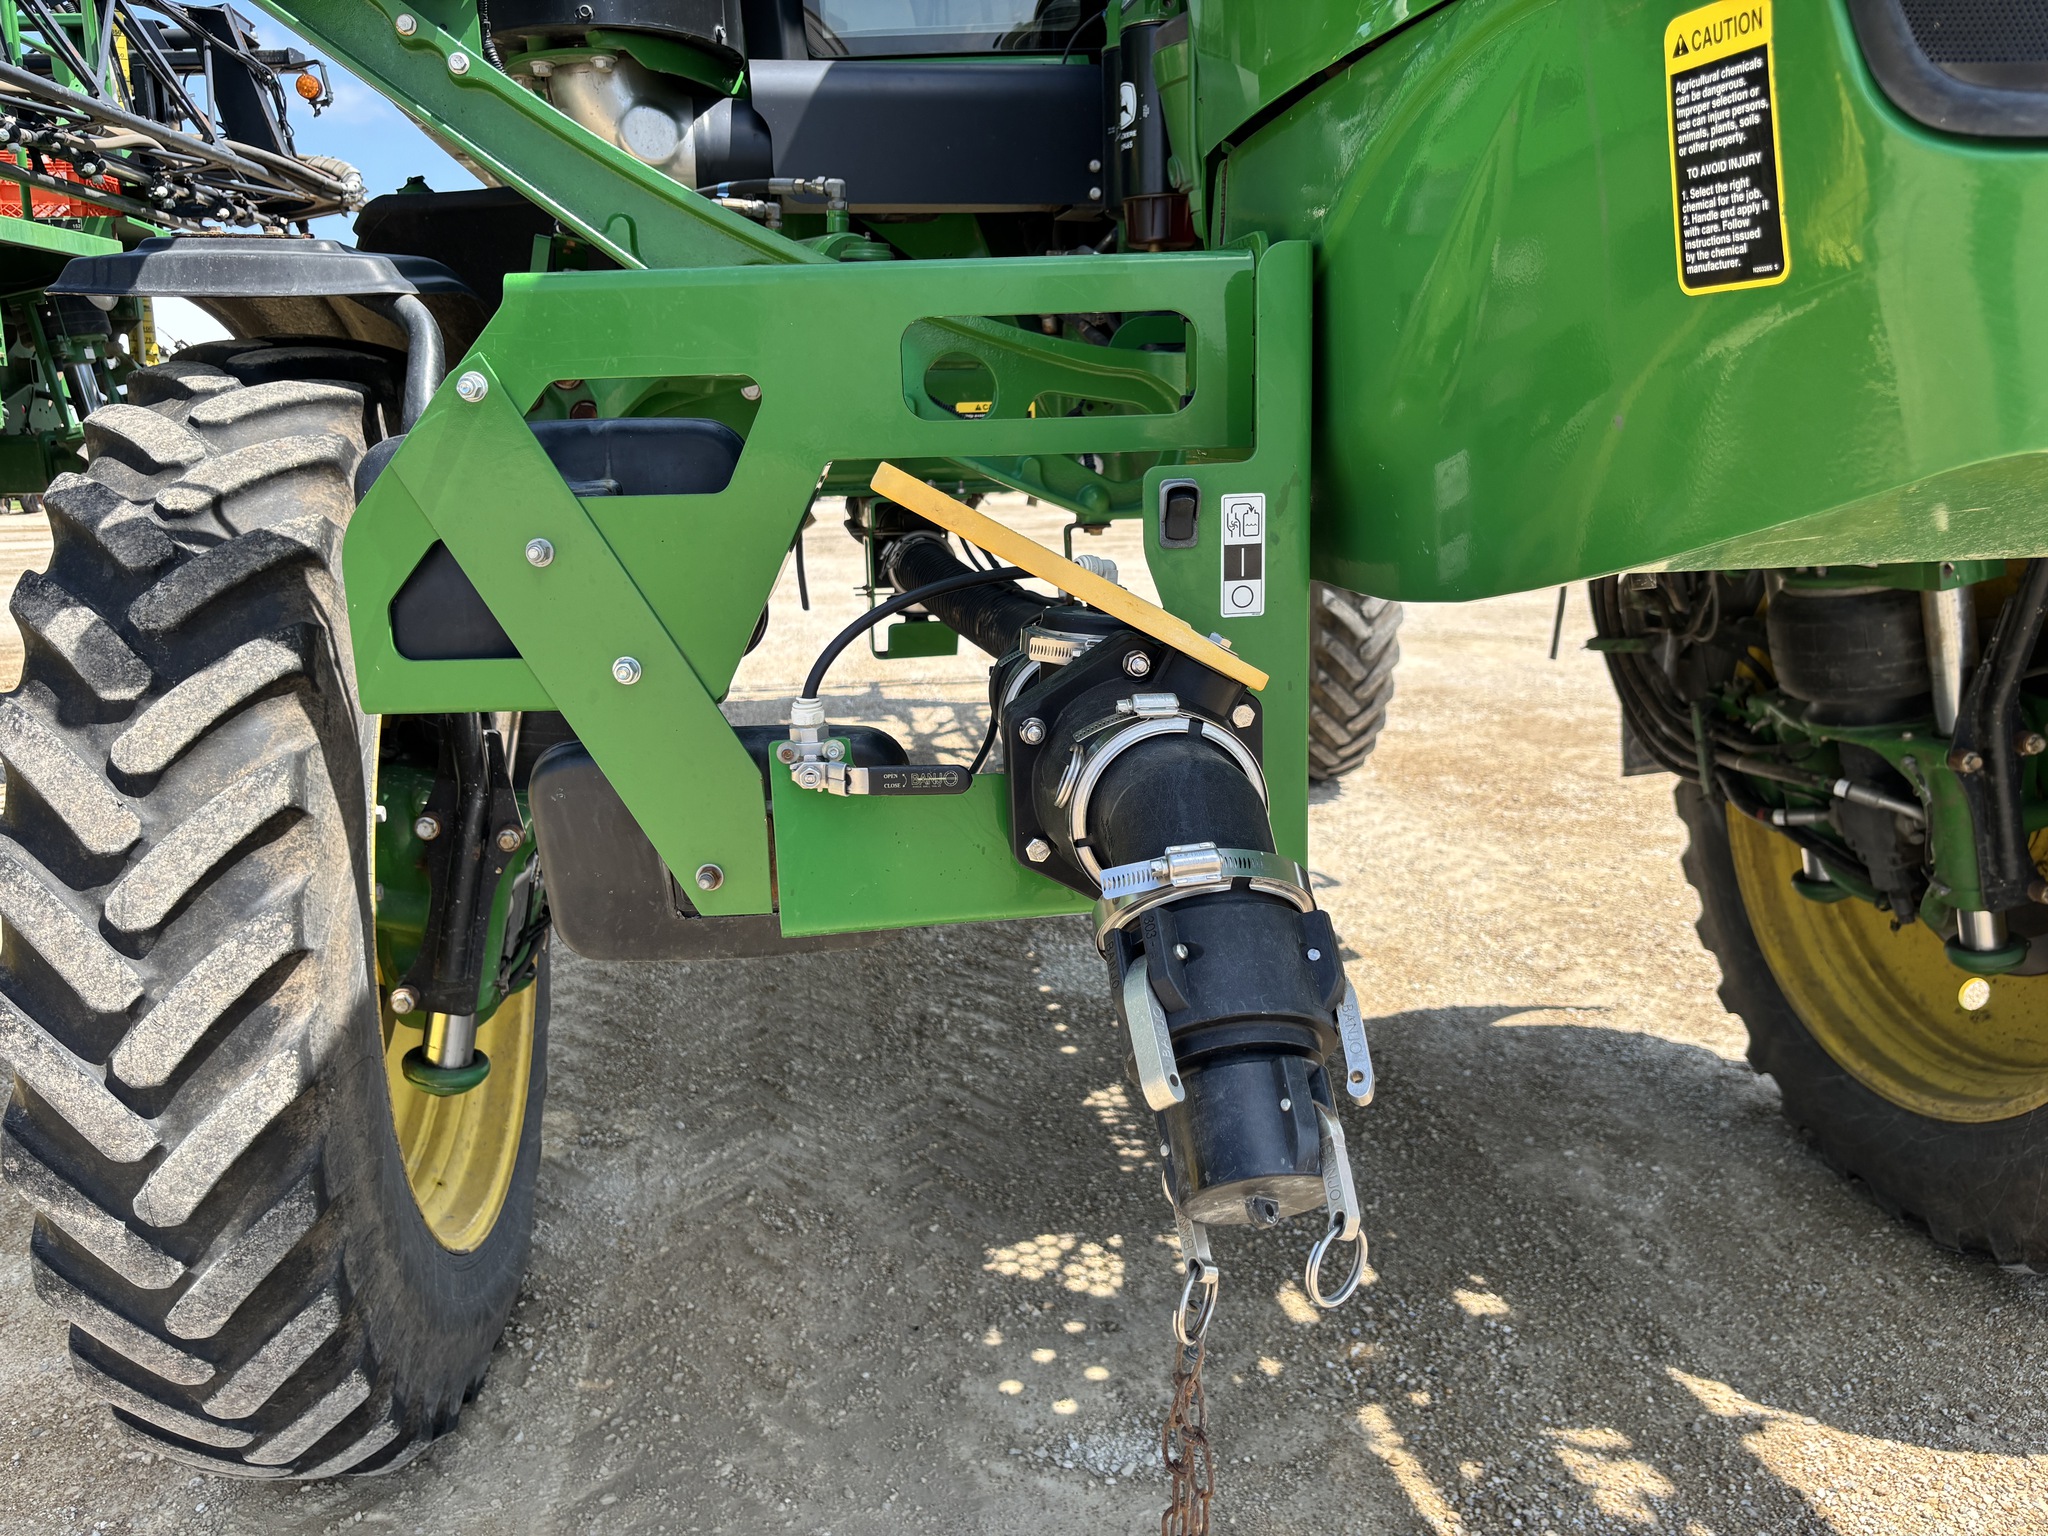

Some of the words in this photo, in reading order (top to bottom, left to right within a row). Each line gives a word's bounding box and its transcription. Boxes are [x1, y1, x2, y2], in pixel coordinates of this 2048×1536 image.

[1691, 7, 1762, 51] CAUTION
[1676, 70, 1720, 94] Agricultural
[1721, 57, 1764, 79] chemicals
[1676, 95, 1690, 106] can
[1691, 90, 1701, 101] be
[1702, 77, 1747, 97] dangerous.
[1676, 101, 1710, 119] Improper
[1711, 90, 1748, 109] selection
[1750, 87, 1760, 97] or
[1677, 120, 1690, 131] use
[1692, 117, 1706, 127] can
[1707, 107, 1730, 123] injure
[1731, 98, 1769, 118] persons,
[1677, 128, 1710, 144] animals,
[1710, 120, 1738, 138] plants,
[1739, 114, 1761, 128] soils
[1678, 148, 1687, 157] or
[1688, 141, 1708, 155] other
[1709, 131, 1747, 151] property.
[1687, 167, 1699, 180] TO
[1700, 160, 1727, 177] AVOID
[1728, 152, 1762, 171] INJURY
[1681, 190, 1689, 201] 1.
[1689, 186, 1714, 199] Select
[1715, 183, 1728, 194] the
[1729, 177, 1750, 192] right
[1682, 197, 1716, 213] chemical
[1717, 195, 1729, 207] for
[1731, 192, 1744, 204] the
[1746, 188, 1763, 203] job.
[1683, 215, 1691, 226] 2.
[1691, 210, 1719, 224] Handle
[1720, 206, 1736, 219] and
[1737, 202, 1760, 217] apply
[1761, 199, 1769, 211] it
[1684, 227, 1700, 238] with
[1701, 224, 1721, 236] care.
[1722, 218, 1750, 231] Follow
[1684, 234, 1731, 250] instructions
[1732, 228, 1761, 242] issued
[1685, 252, 1695, 264] by
[1696, 250, 1709, 261] the
[1710, 242, 1748, 258] chemical
[1686, 259, 1741, 275] manufacturer.
[1105, 940, 1120, 990] BANJO
[1152, 1005, 1172, 1058] BANJO
[1342, 1004, 1363, 1054] BANJO
[1320, 1136, 1342, 1202] BANJO
